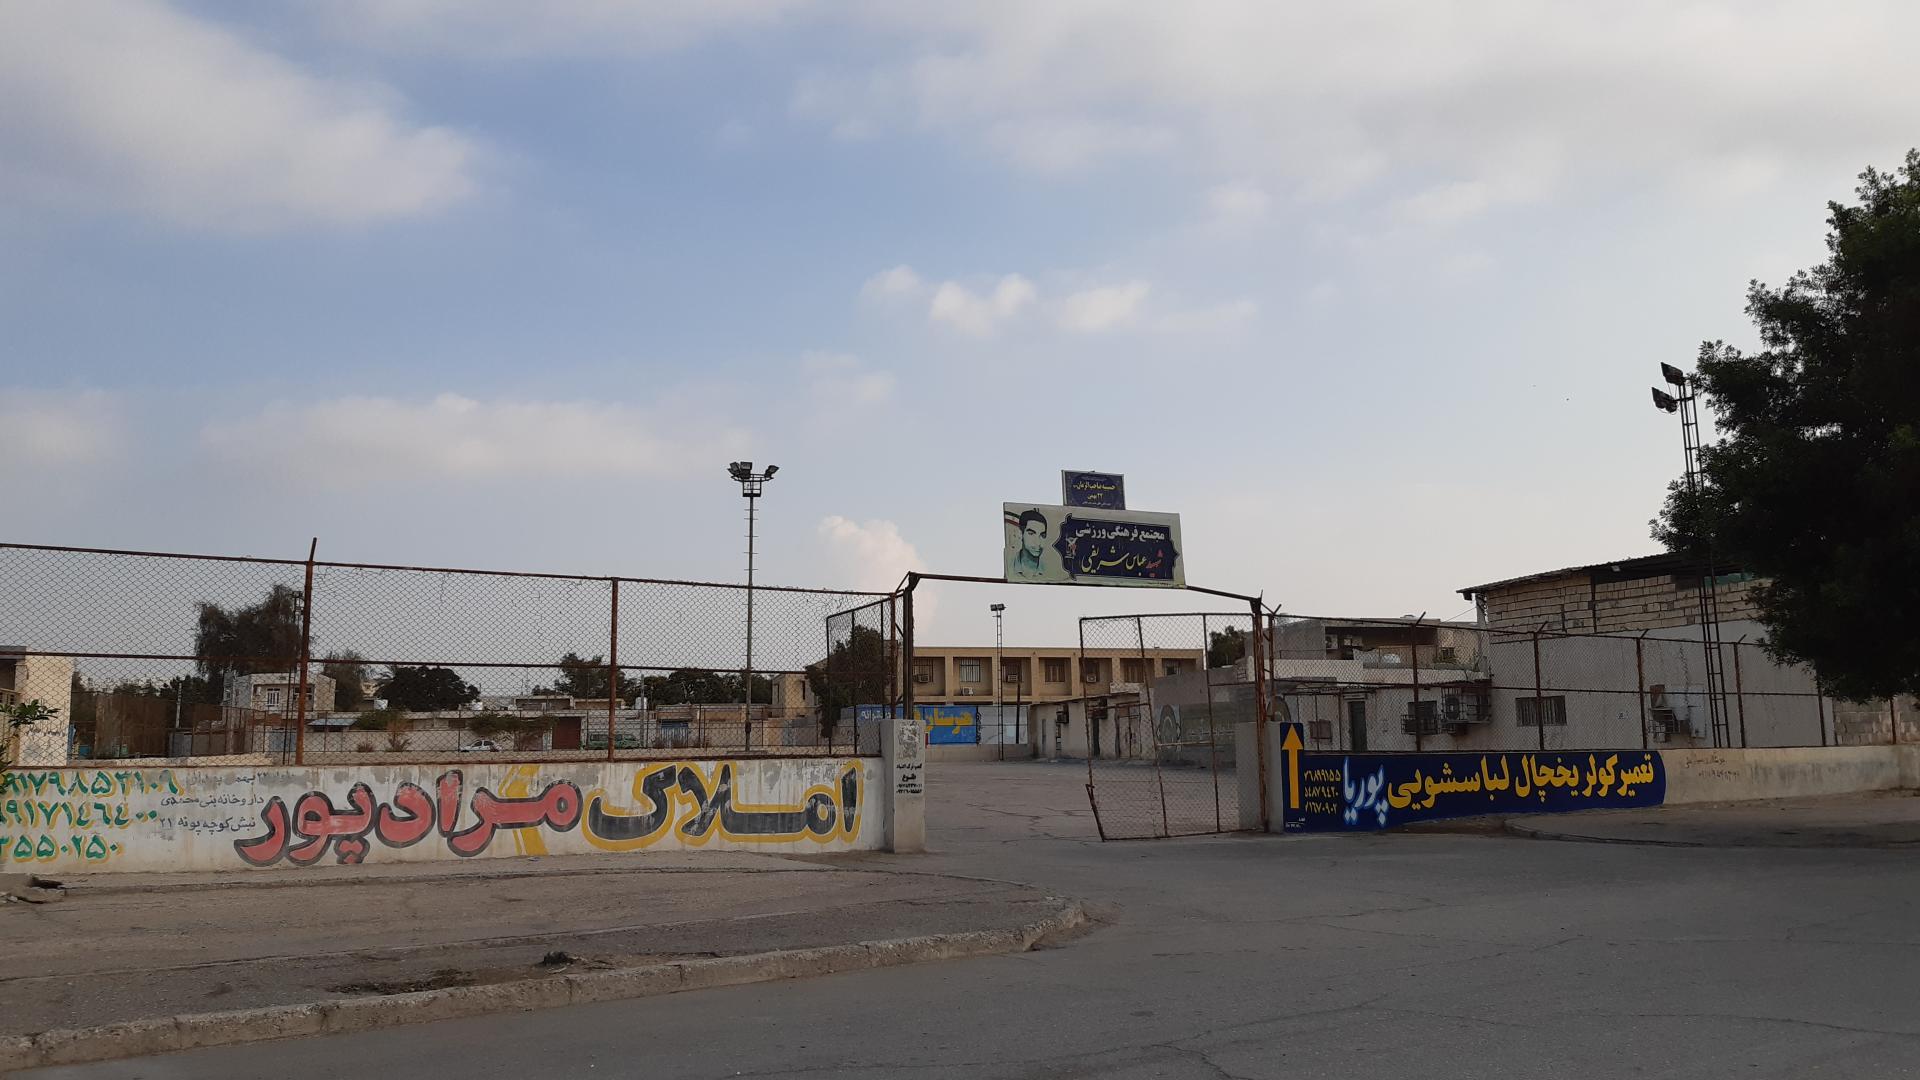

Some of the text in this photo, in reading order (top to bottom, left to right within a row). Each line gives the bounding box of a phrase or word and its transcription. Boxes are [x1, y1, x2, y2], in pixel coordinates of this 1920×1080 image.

[1075, 523, 1165, 542] مجتمع فرهنگی ورزشی
[1081, 544, 1164, 577] شهید عباس شریفی
[218, 794, 264, 806] داروخانه
[1343, 753, 1654, 828] تعمیر کولر یخچال لباسشویی پوریا
[160, 817, 172, 828] ۲۱
[234, 760, 863, 867] املاک مرادپور
[202, 816, 233, 835] کوچه
[231, 816, 256, 832] نبش
